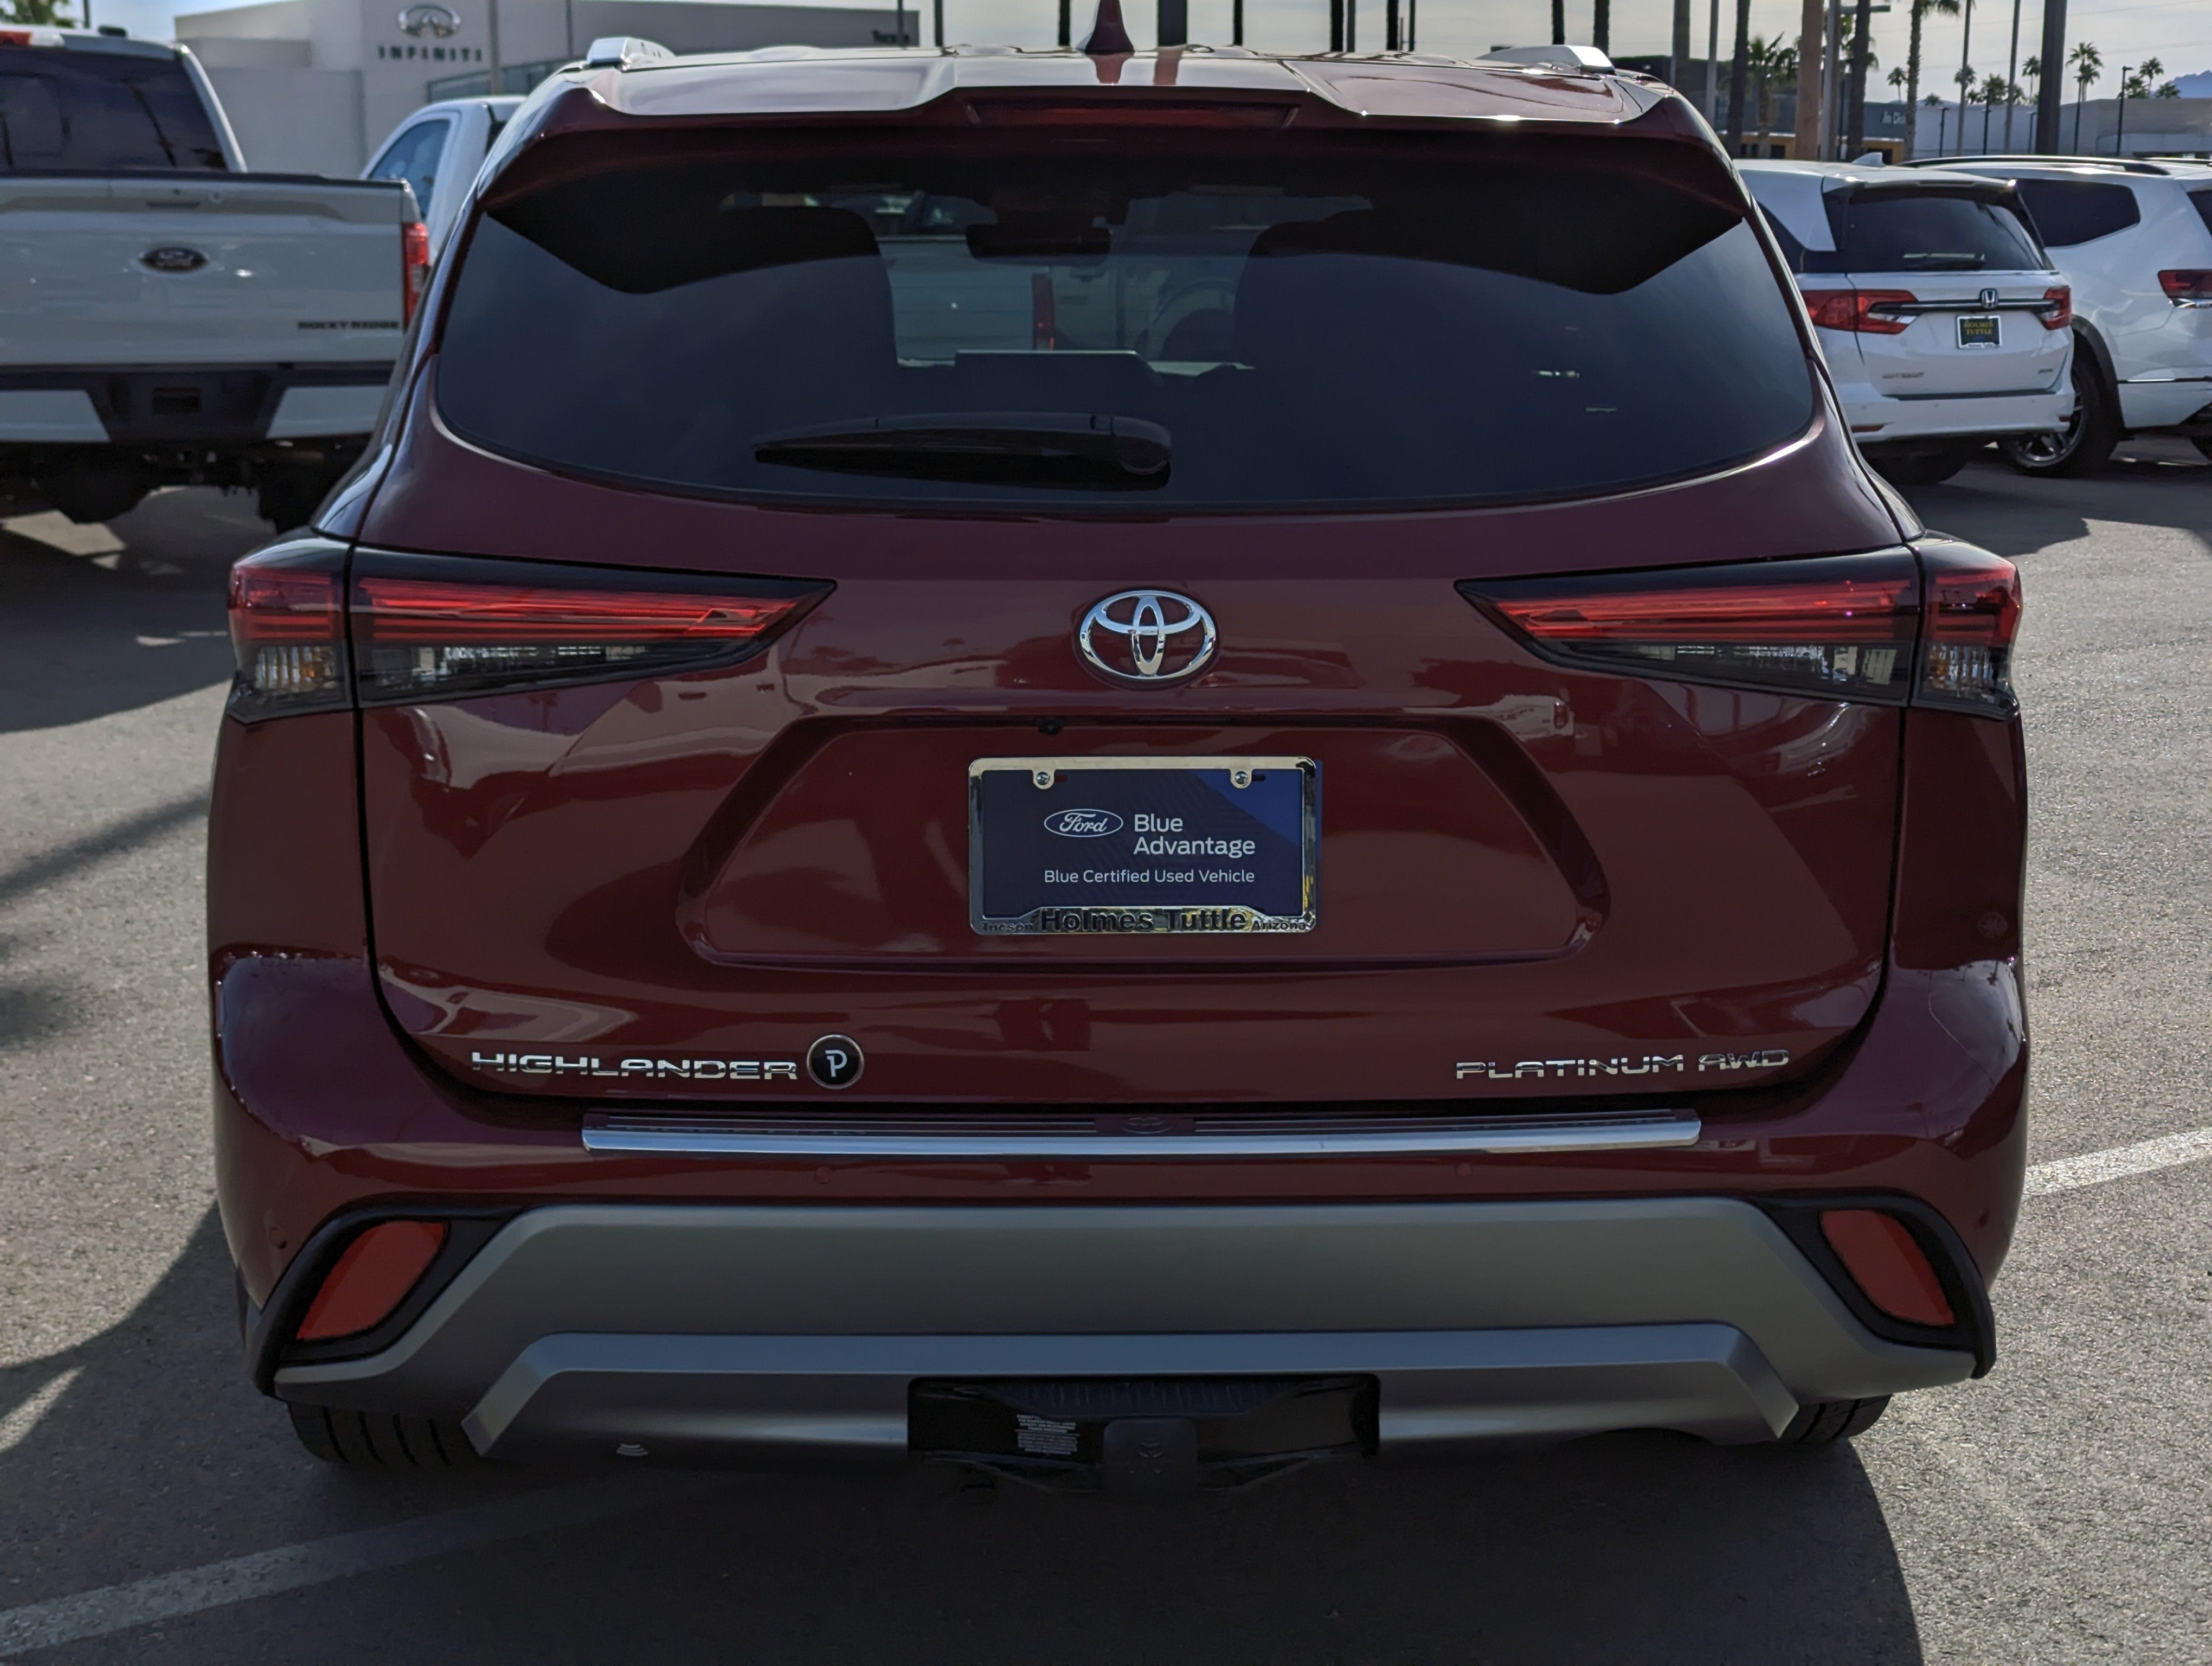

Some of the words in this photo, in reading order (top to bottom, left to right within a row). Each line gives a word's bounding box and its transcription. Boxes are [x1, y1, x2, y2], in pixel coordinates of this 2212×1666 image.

[378, 44, 483, 62] INFINITI
[298, 321, 348, 330] ROCKY
[1059, 812, 1108, 832] Ford
[1134, 813, 1184, 832] Blue
[1133, 836, 1256, 858] Advantage
[1044, 870, 1079, 883] Blue
[1083, 869, 1149, 882] Certified
[1155, 869, 1194, 882] Used
[1199, 869, 1255, 882] Vehicle
[981, 922, 1033, 932] Tucson
[1040, 908, 1154, 932] Holmes
[1164, 908, 1247, 931] Tuttle
[1251, 920, 1307, 932] Arizona
[471, 1051, 798, 1080] HIGHLANDER
[825, 1049, 847, 1078] P
[1456, 1054, 1684, 1079] PLATINUM
[1698, 1049, 1790, 1072] AWD
